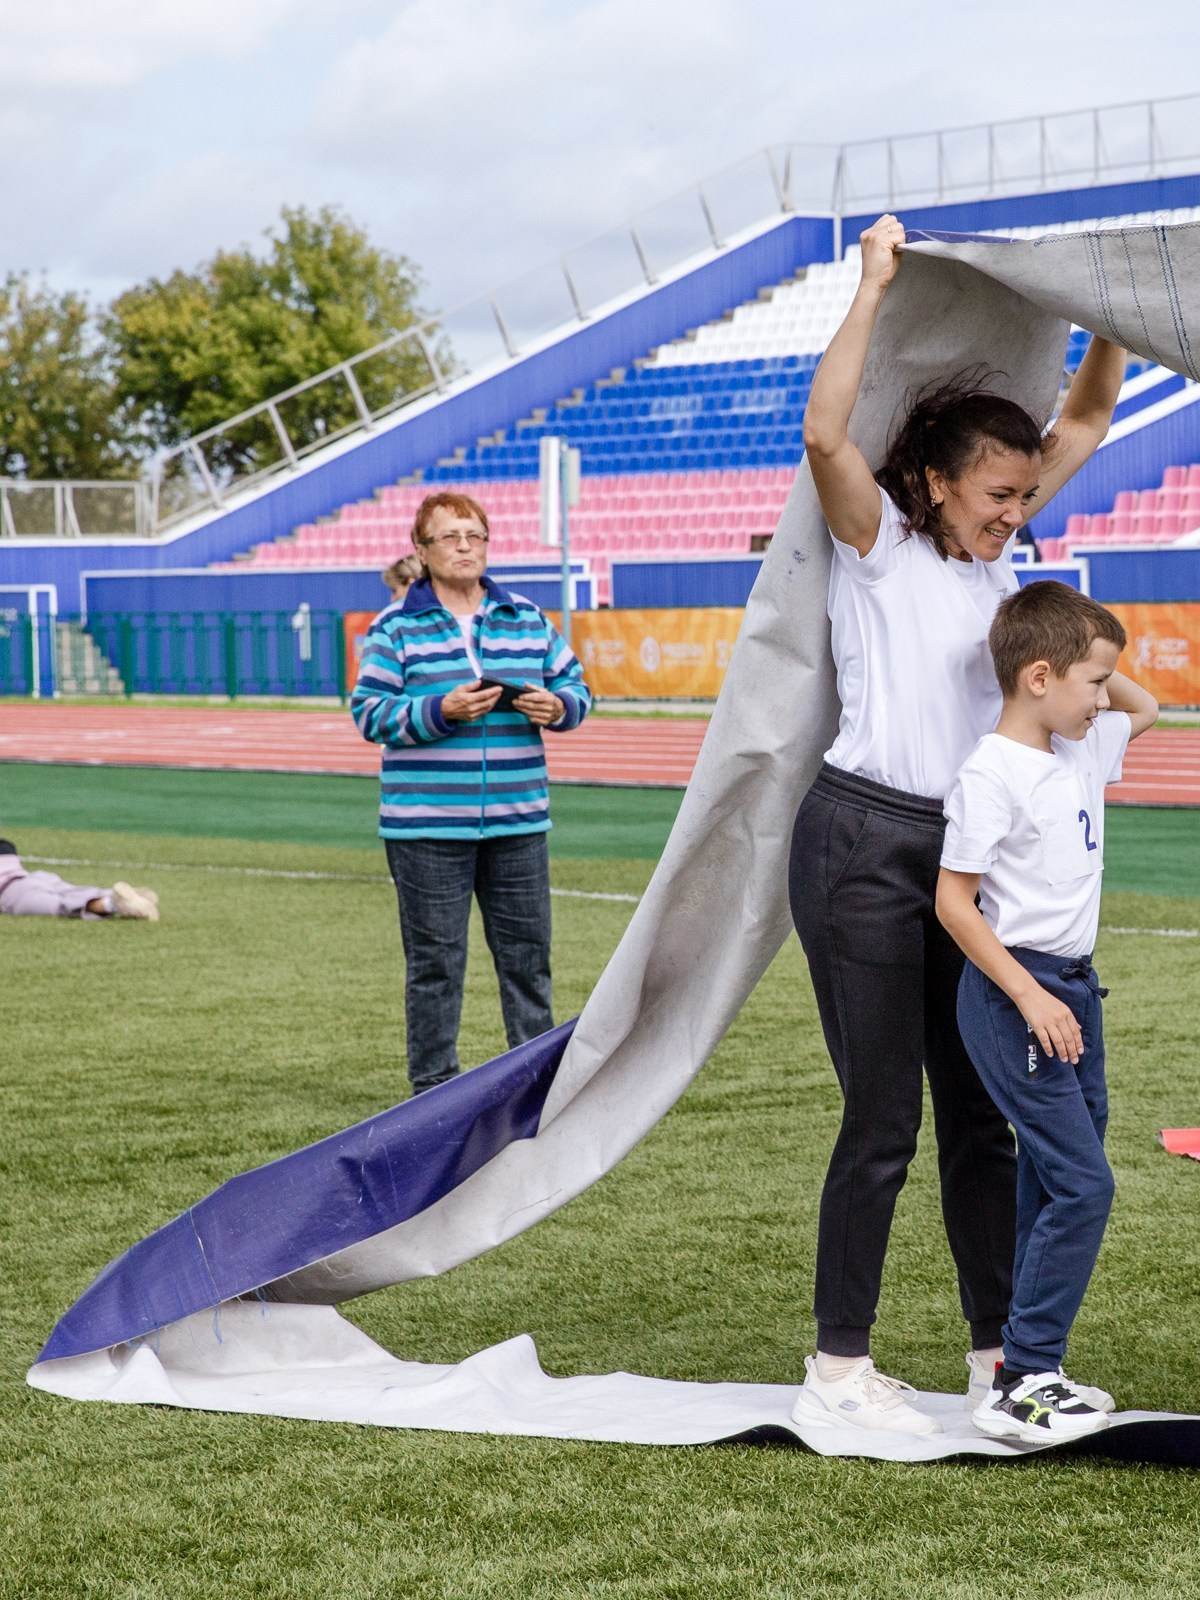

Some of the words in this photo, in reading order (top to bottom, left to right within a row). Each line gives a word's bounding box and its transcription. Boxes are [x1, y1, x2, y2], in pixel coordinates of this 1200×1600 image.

[1078, 809, 1097, 851] 2
[1028, 1044, 1037, 1072] FILA
[1023, 1381, 1040, 1392] COOL
